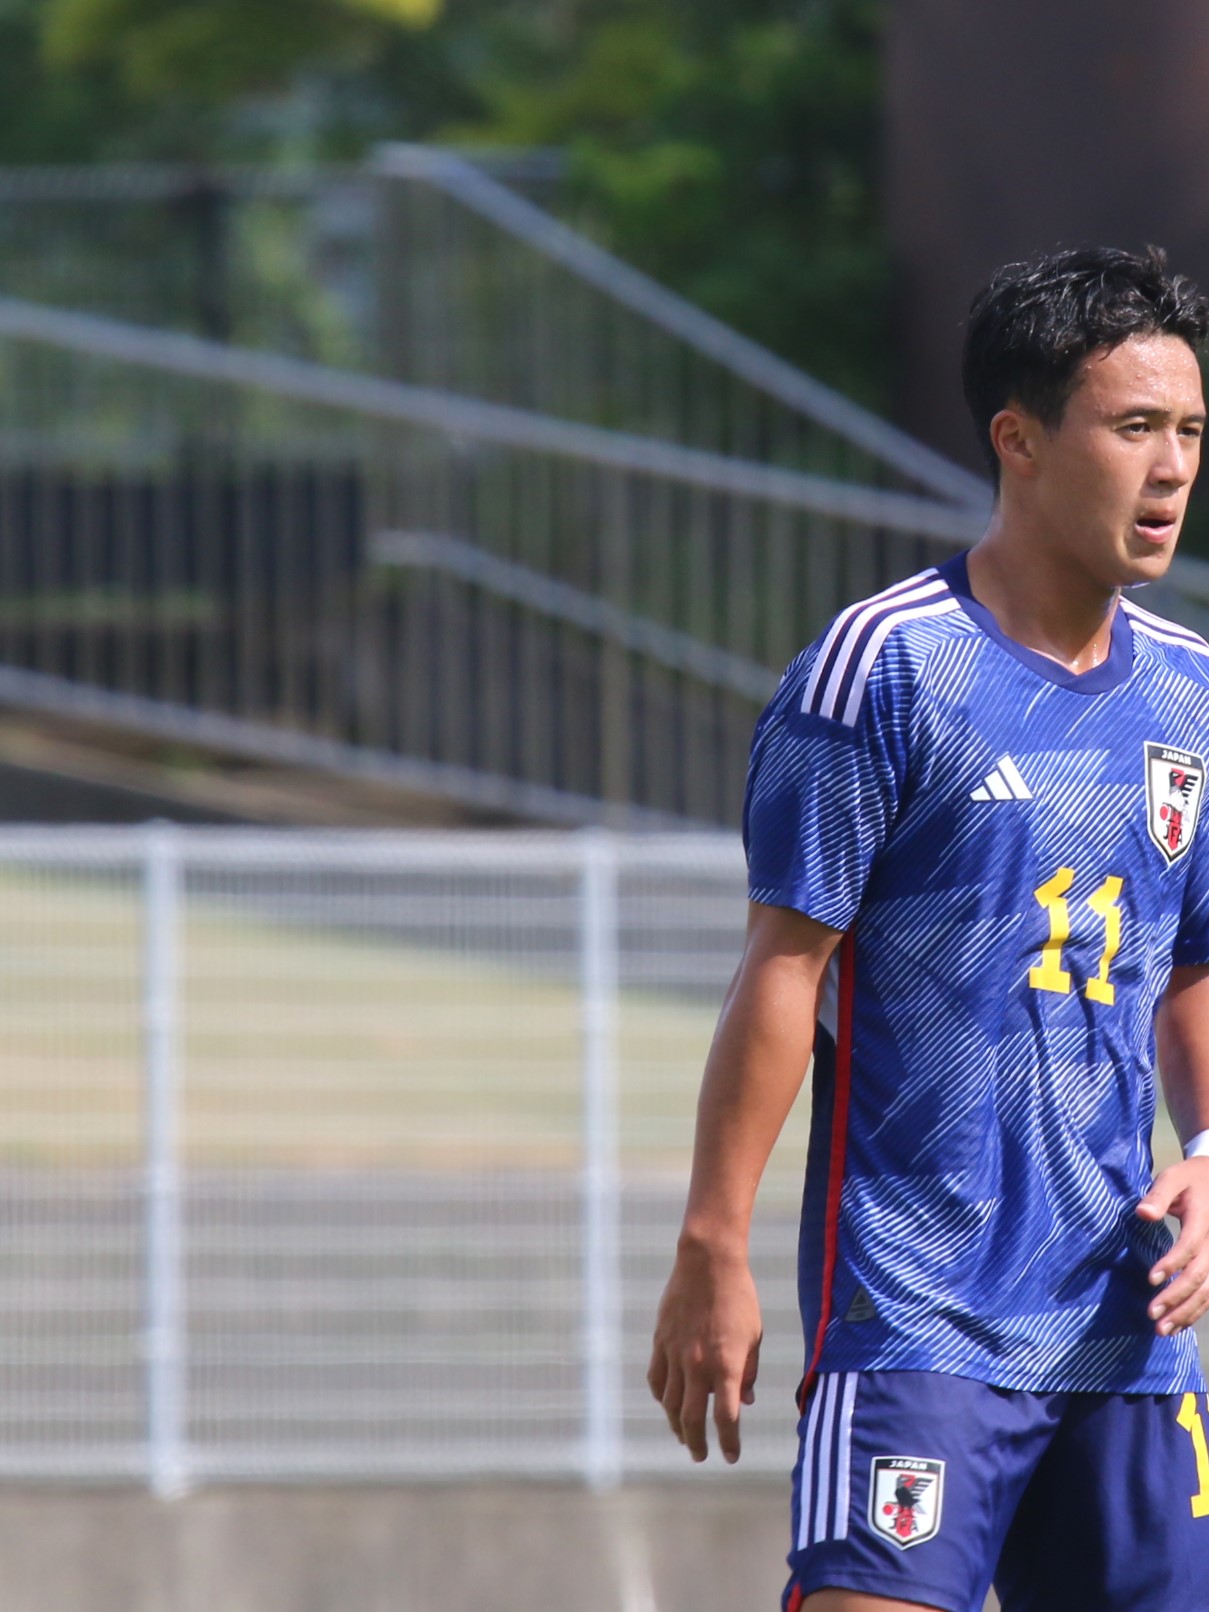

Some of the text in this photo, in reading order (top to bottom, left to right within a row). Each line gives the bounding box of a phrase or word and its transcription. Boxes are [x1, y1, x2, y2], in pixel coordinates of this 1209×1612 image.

[1161, 750, 1192, 766] JAPAN
[1163, 824, 1182, 844] JFA
[1029, 867, 1124, 1006] 11
[889, 1460, 928, 1470] JAPAN
